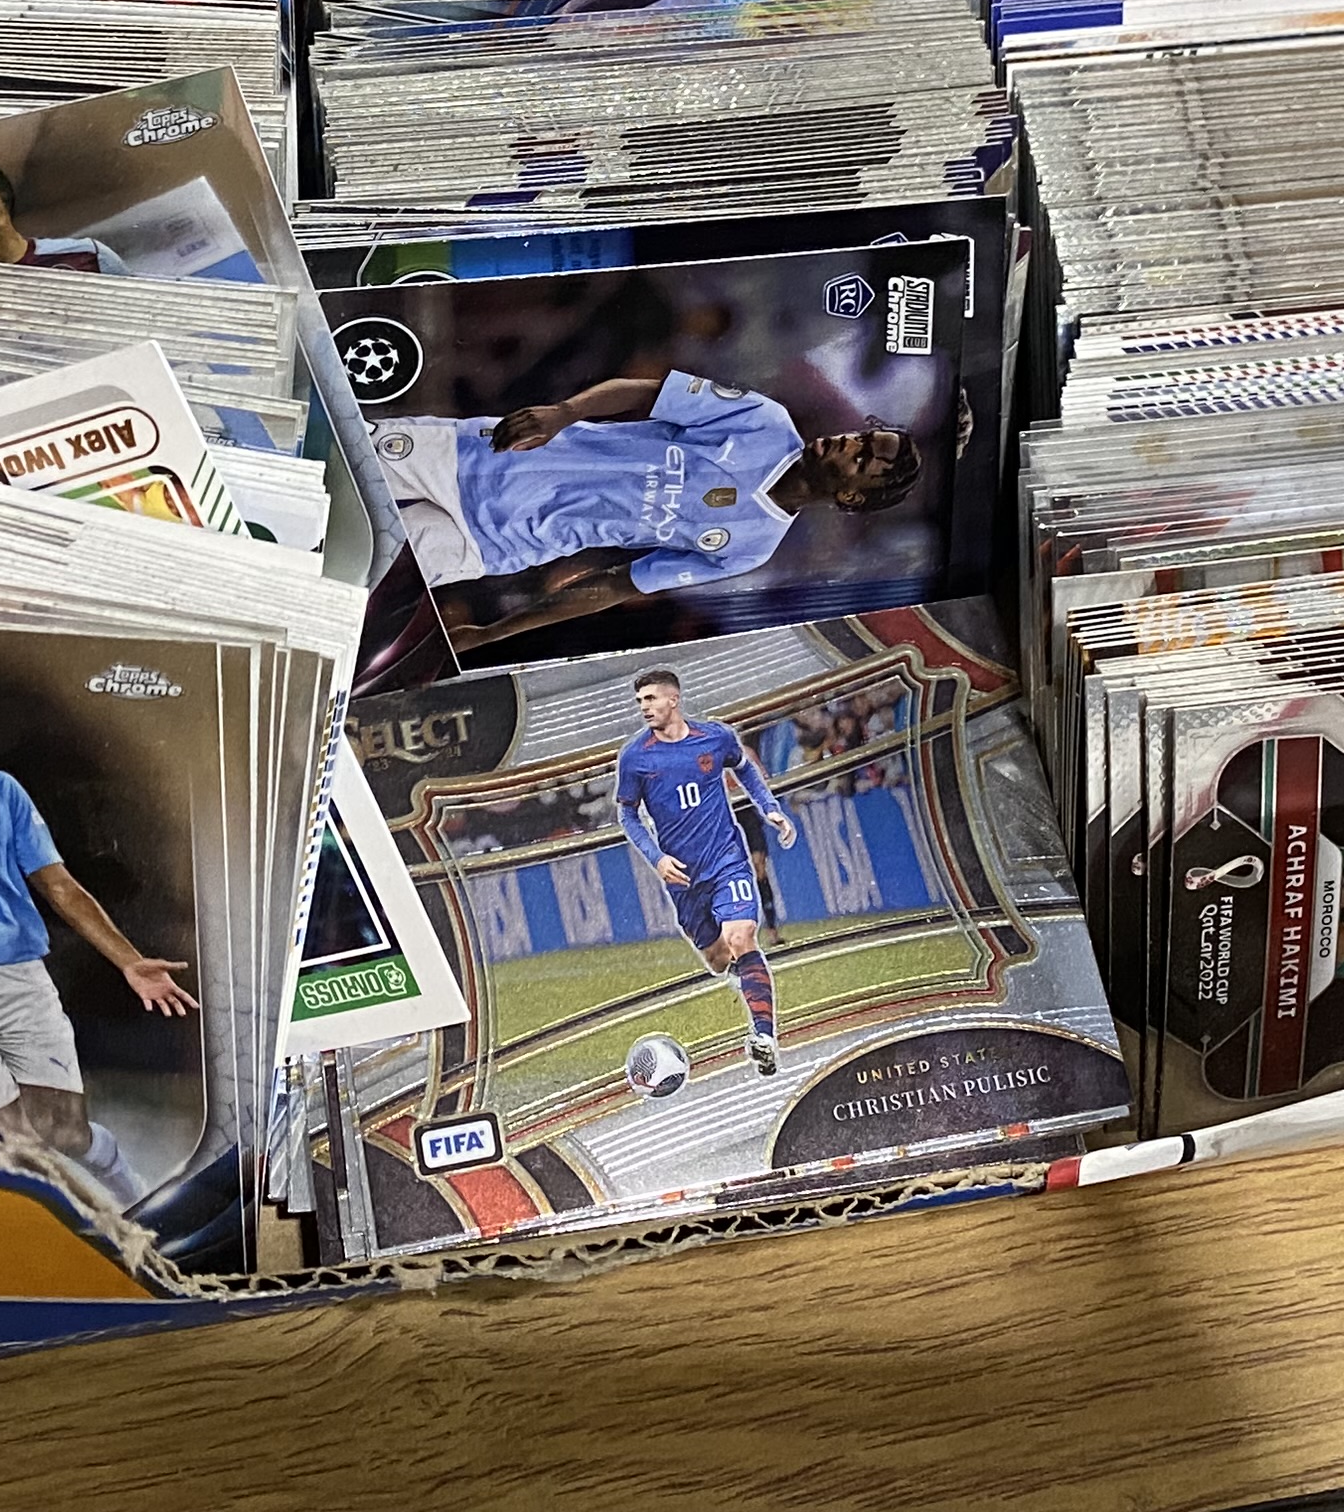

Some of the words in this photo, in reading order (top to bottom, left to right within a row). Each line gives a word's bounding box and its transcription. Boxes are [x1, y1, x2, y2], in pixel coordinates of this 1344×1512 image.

[126, 116, 215, 147] Chrome
[839, 282, 857, 313] RC
[886, 277, 905, 354] Chrome
[65, 419, 137, 460] Alex
[656, 445, 685, 542] ETIHAD
[87, 677, 183, 697] Chrome
[676, 782, 702, 810] 10
[1283, 824, 1308, 919] ACHRAF
[728, 879, 754, 903] 10
[1219, 896, 1234, 928] FIFA
[1319, 880, 1335, 959] MOROCCO
[1216, 927, 1232, 978] WORLD
[1276, 925, 1302, 1020] HAKIMI
[1215, 978, 1230, 1005] CUP
[856, 1059, 931, 1084] UNITED
[832, 1083, 958, 1122] CHRISTIAN
[963, 1065, 1052, 1097] PULISIC
[429, 1131, 485, 1158] FIFA
